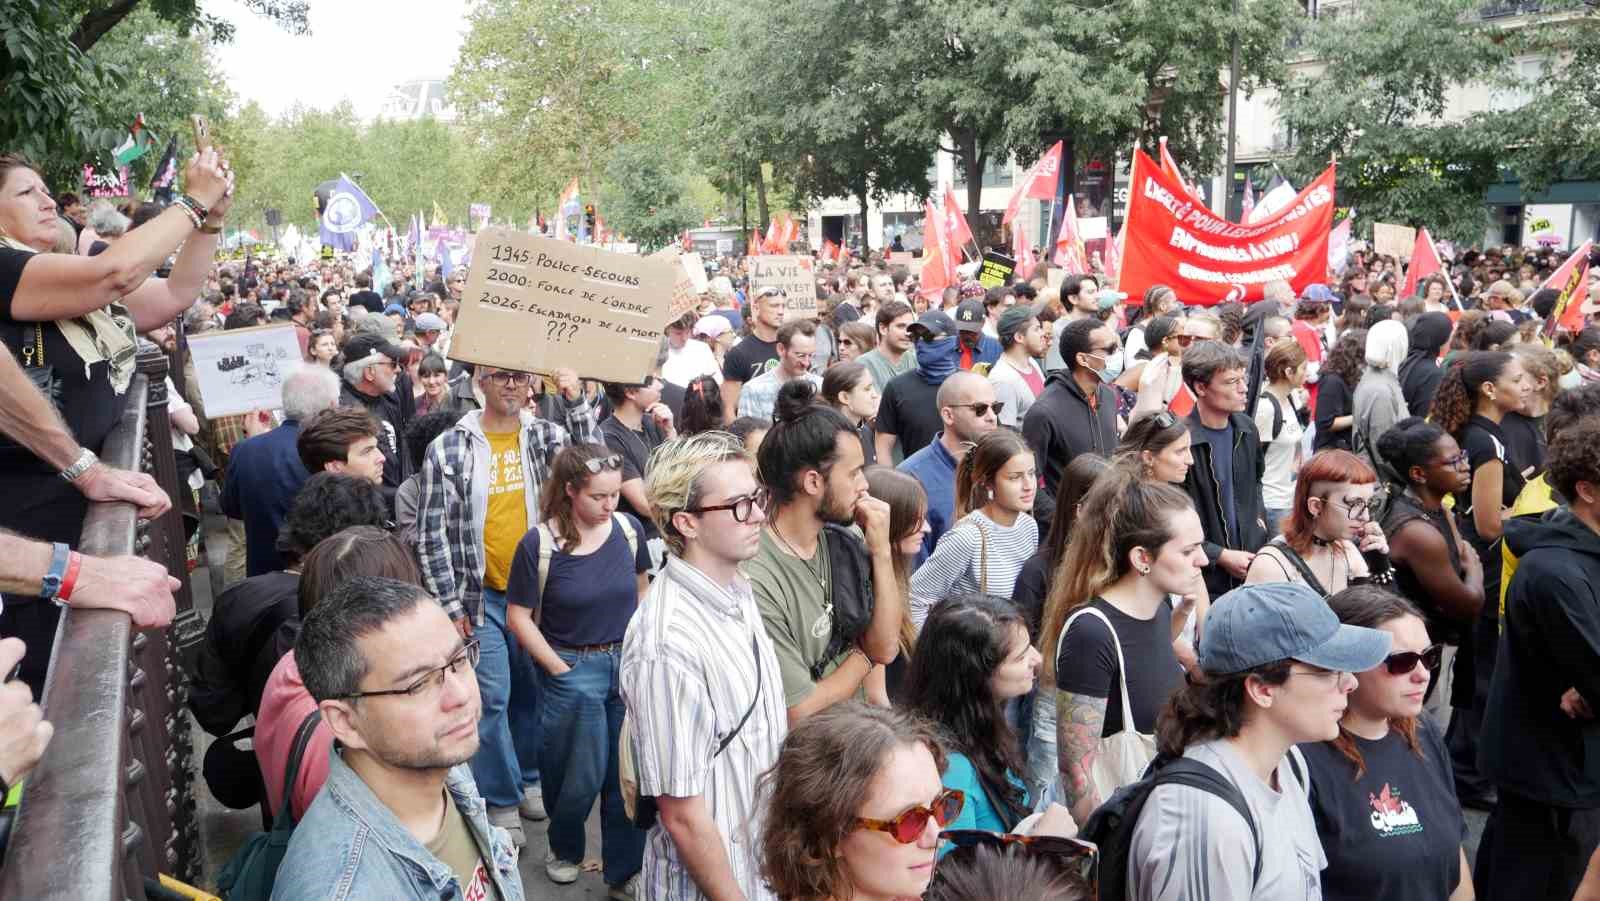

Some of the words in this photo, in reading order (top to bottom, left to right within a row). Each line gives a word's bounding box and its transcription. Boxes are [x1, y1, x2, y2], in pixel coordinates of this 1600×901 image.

[1183, 209, 1228, 234] POUR
[491, 244, 534, 264] 1945:
[754, 262, 774, 278] LA
[777, 265, 799, 279] VIE
[487, 268, 532, 288] 2000:
[537, 280, 576, 296] FORCE
[581, 291, 598, 302] DE
[601, 296, 653, 314] L'ORDRE
[479, 292, 525, 311] 2026:
[598, 320, 612, 329] DE
[615, 324, 628, 333] LA
[631, 328, 660, 338] MORT
[546, 320, 579, 344] ???
